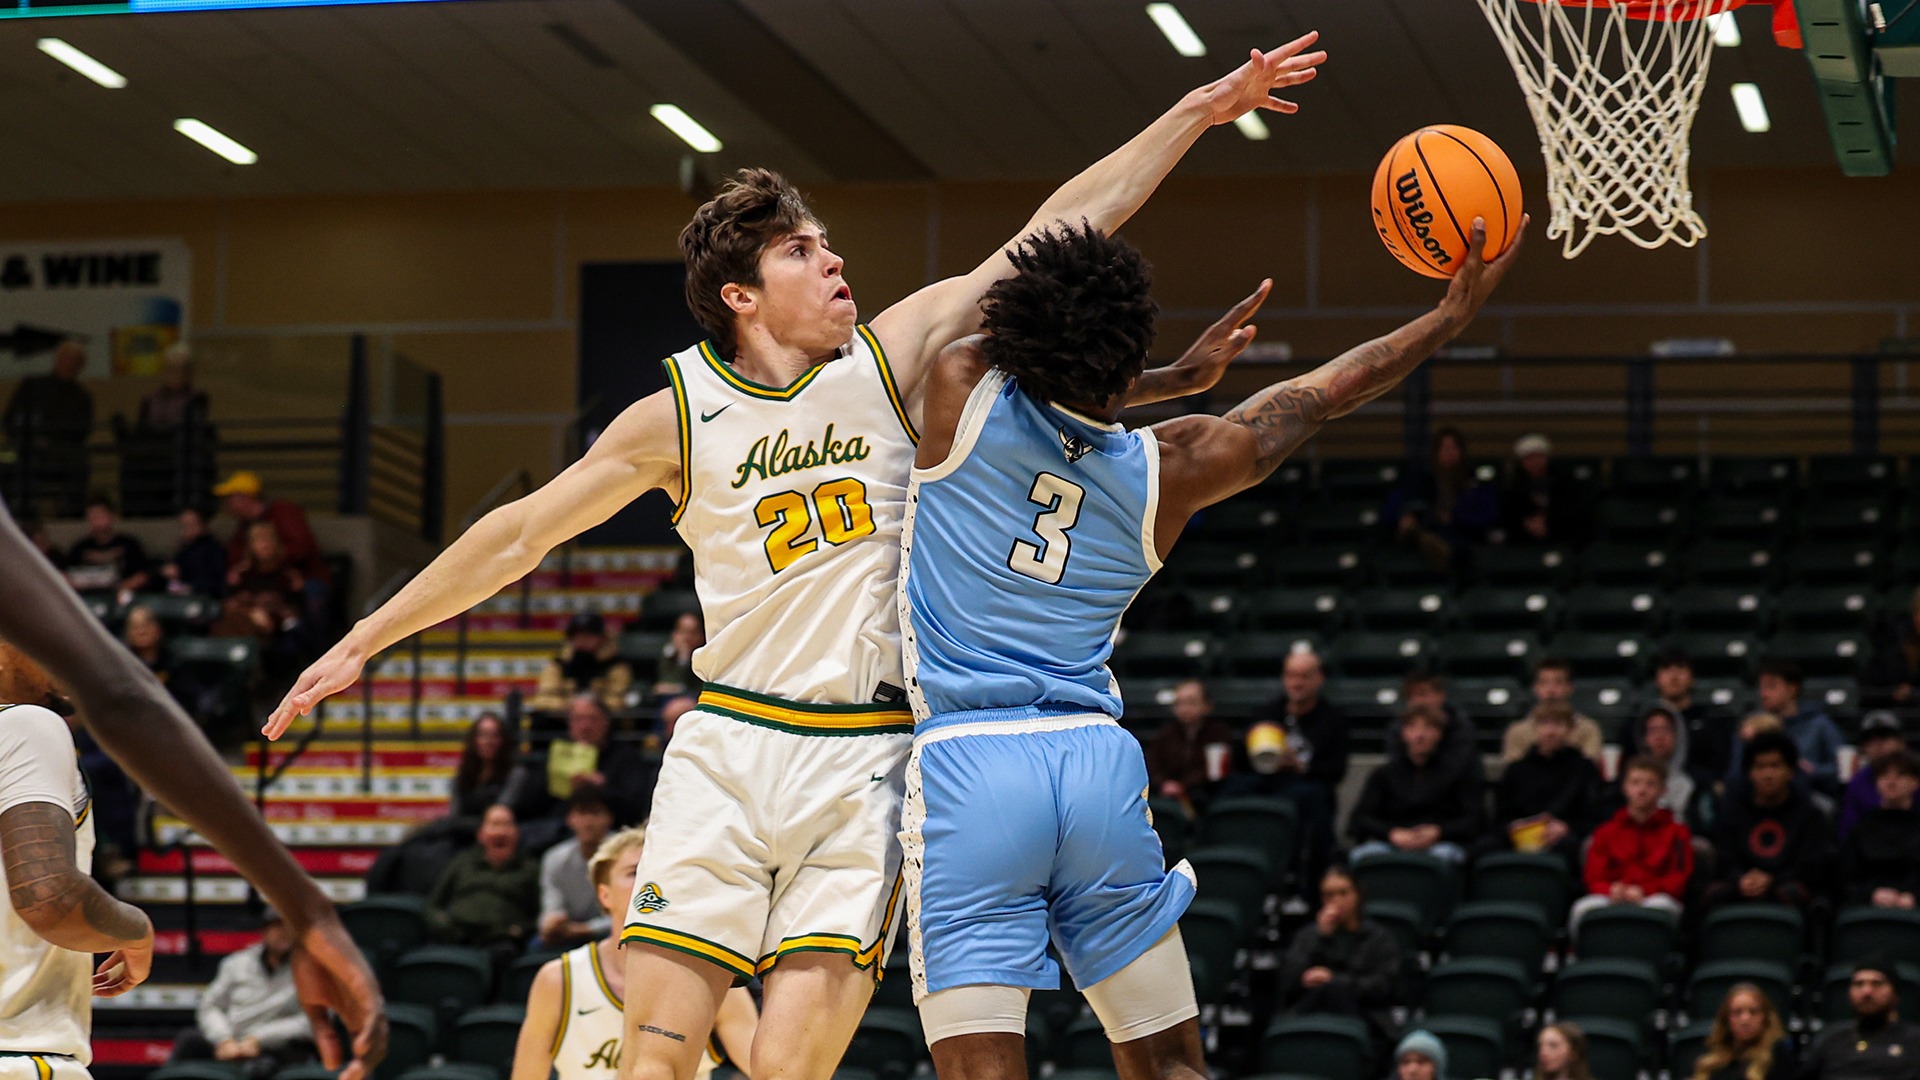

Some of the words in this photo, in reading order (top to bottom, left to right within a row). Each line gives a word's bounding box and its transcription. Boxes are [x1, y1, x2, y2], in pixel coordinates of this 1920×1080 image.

[1396, 168, 1452, 266] Wilson
[45, 253, 159, 287] WINE
[731, 423, 870, 489] Alaska
[753, 476, 877, 575] 20
[1007, 471, 1086, 586] 3
